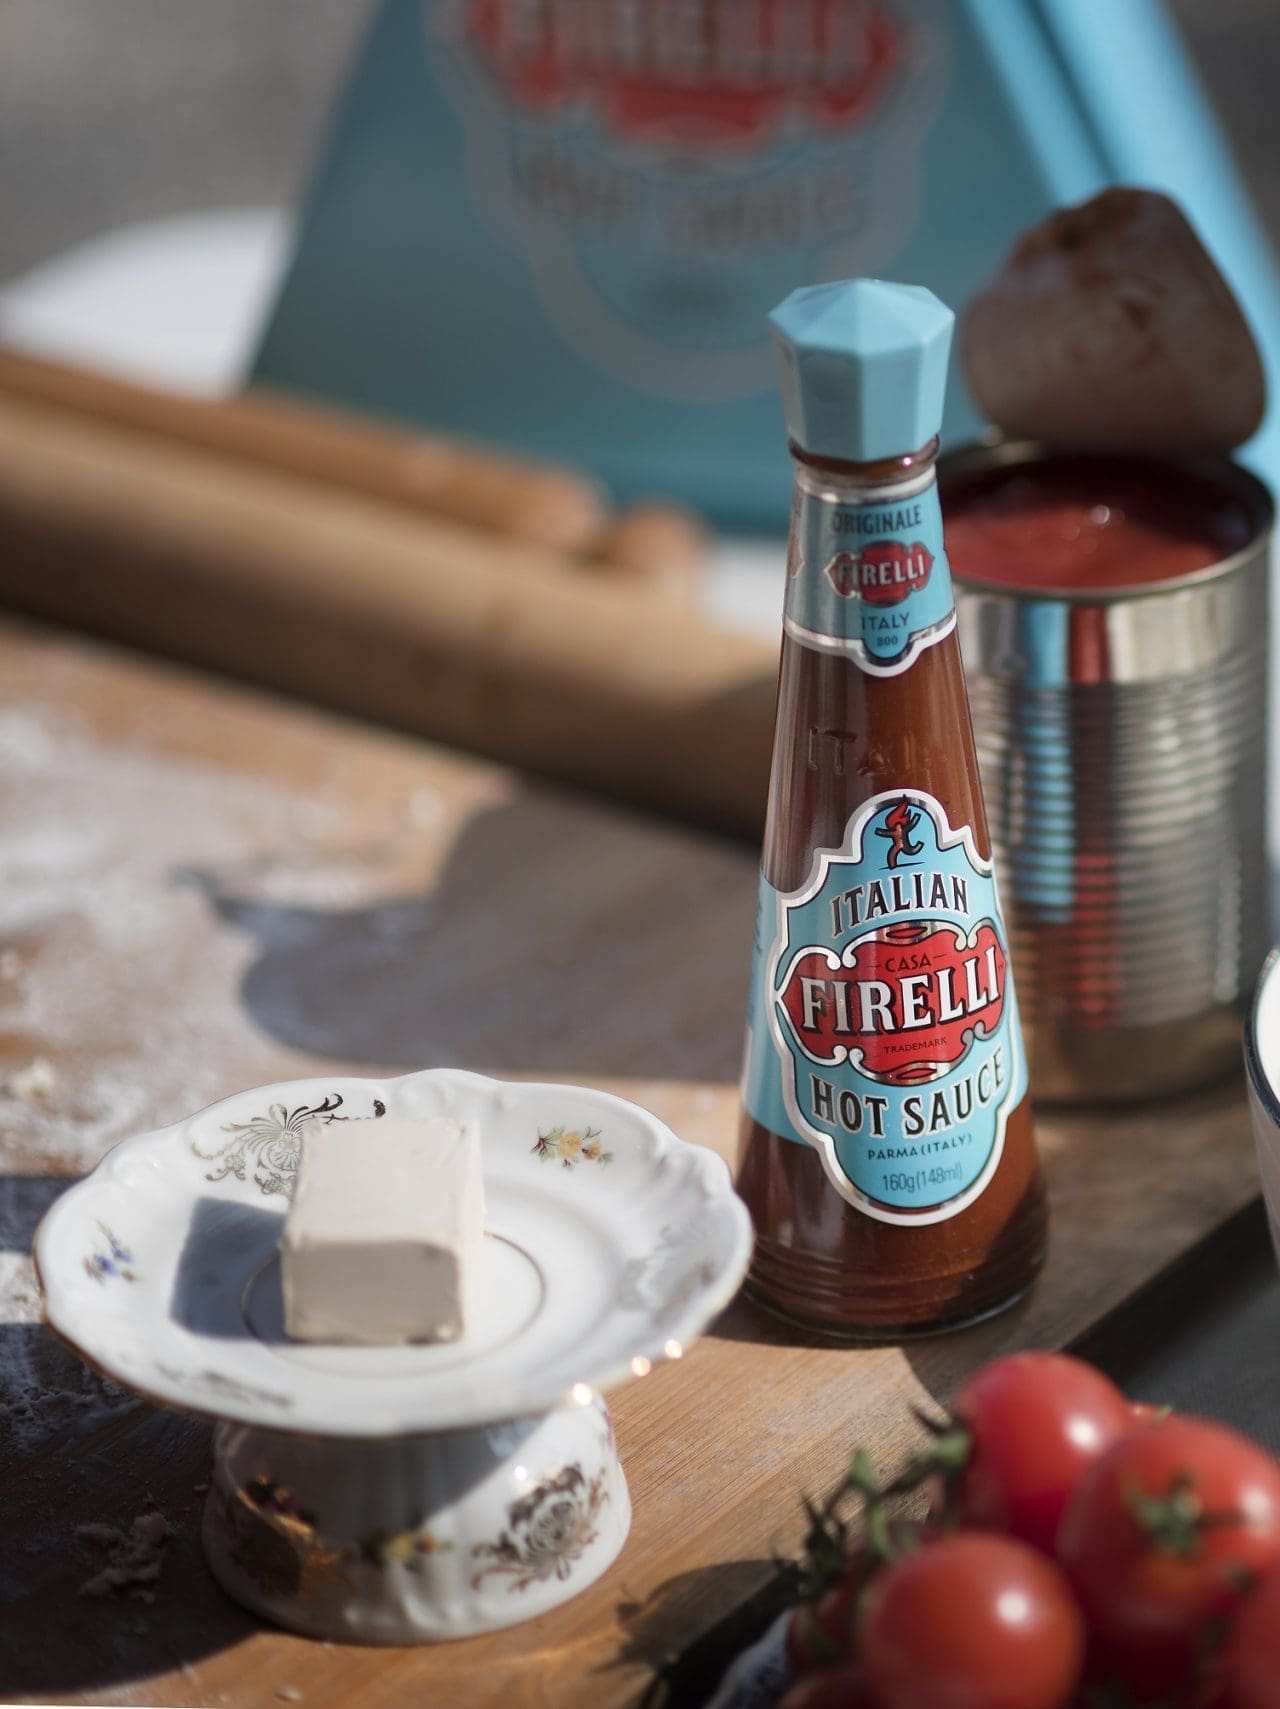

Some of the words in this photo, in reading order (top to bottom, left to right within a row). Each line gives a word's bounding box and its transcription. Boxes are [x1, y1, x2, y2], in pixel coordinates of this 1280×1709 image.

[832, 504, 922, 533] ORIGINALE
[838, 554, 925, 586] FIRELLI
[861, 612, 911, 630] ITALY
[832, 873, 969, 937] ITALIAN
[885, 954, 931, 973] CASA
[800, 945, 1001, 1036] FIRELLI
[883, 1036, 948, 1055] TRADEMARK
[811, 1075, 887, 1136] HOT
[904, 1048, 1003, 1136] SAUCE
